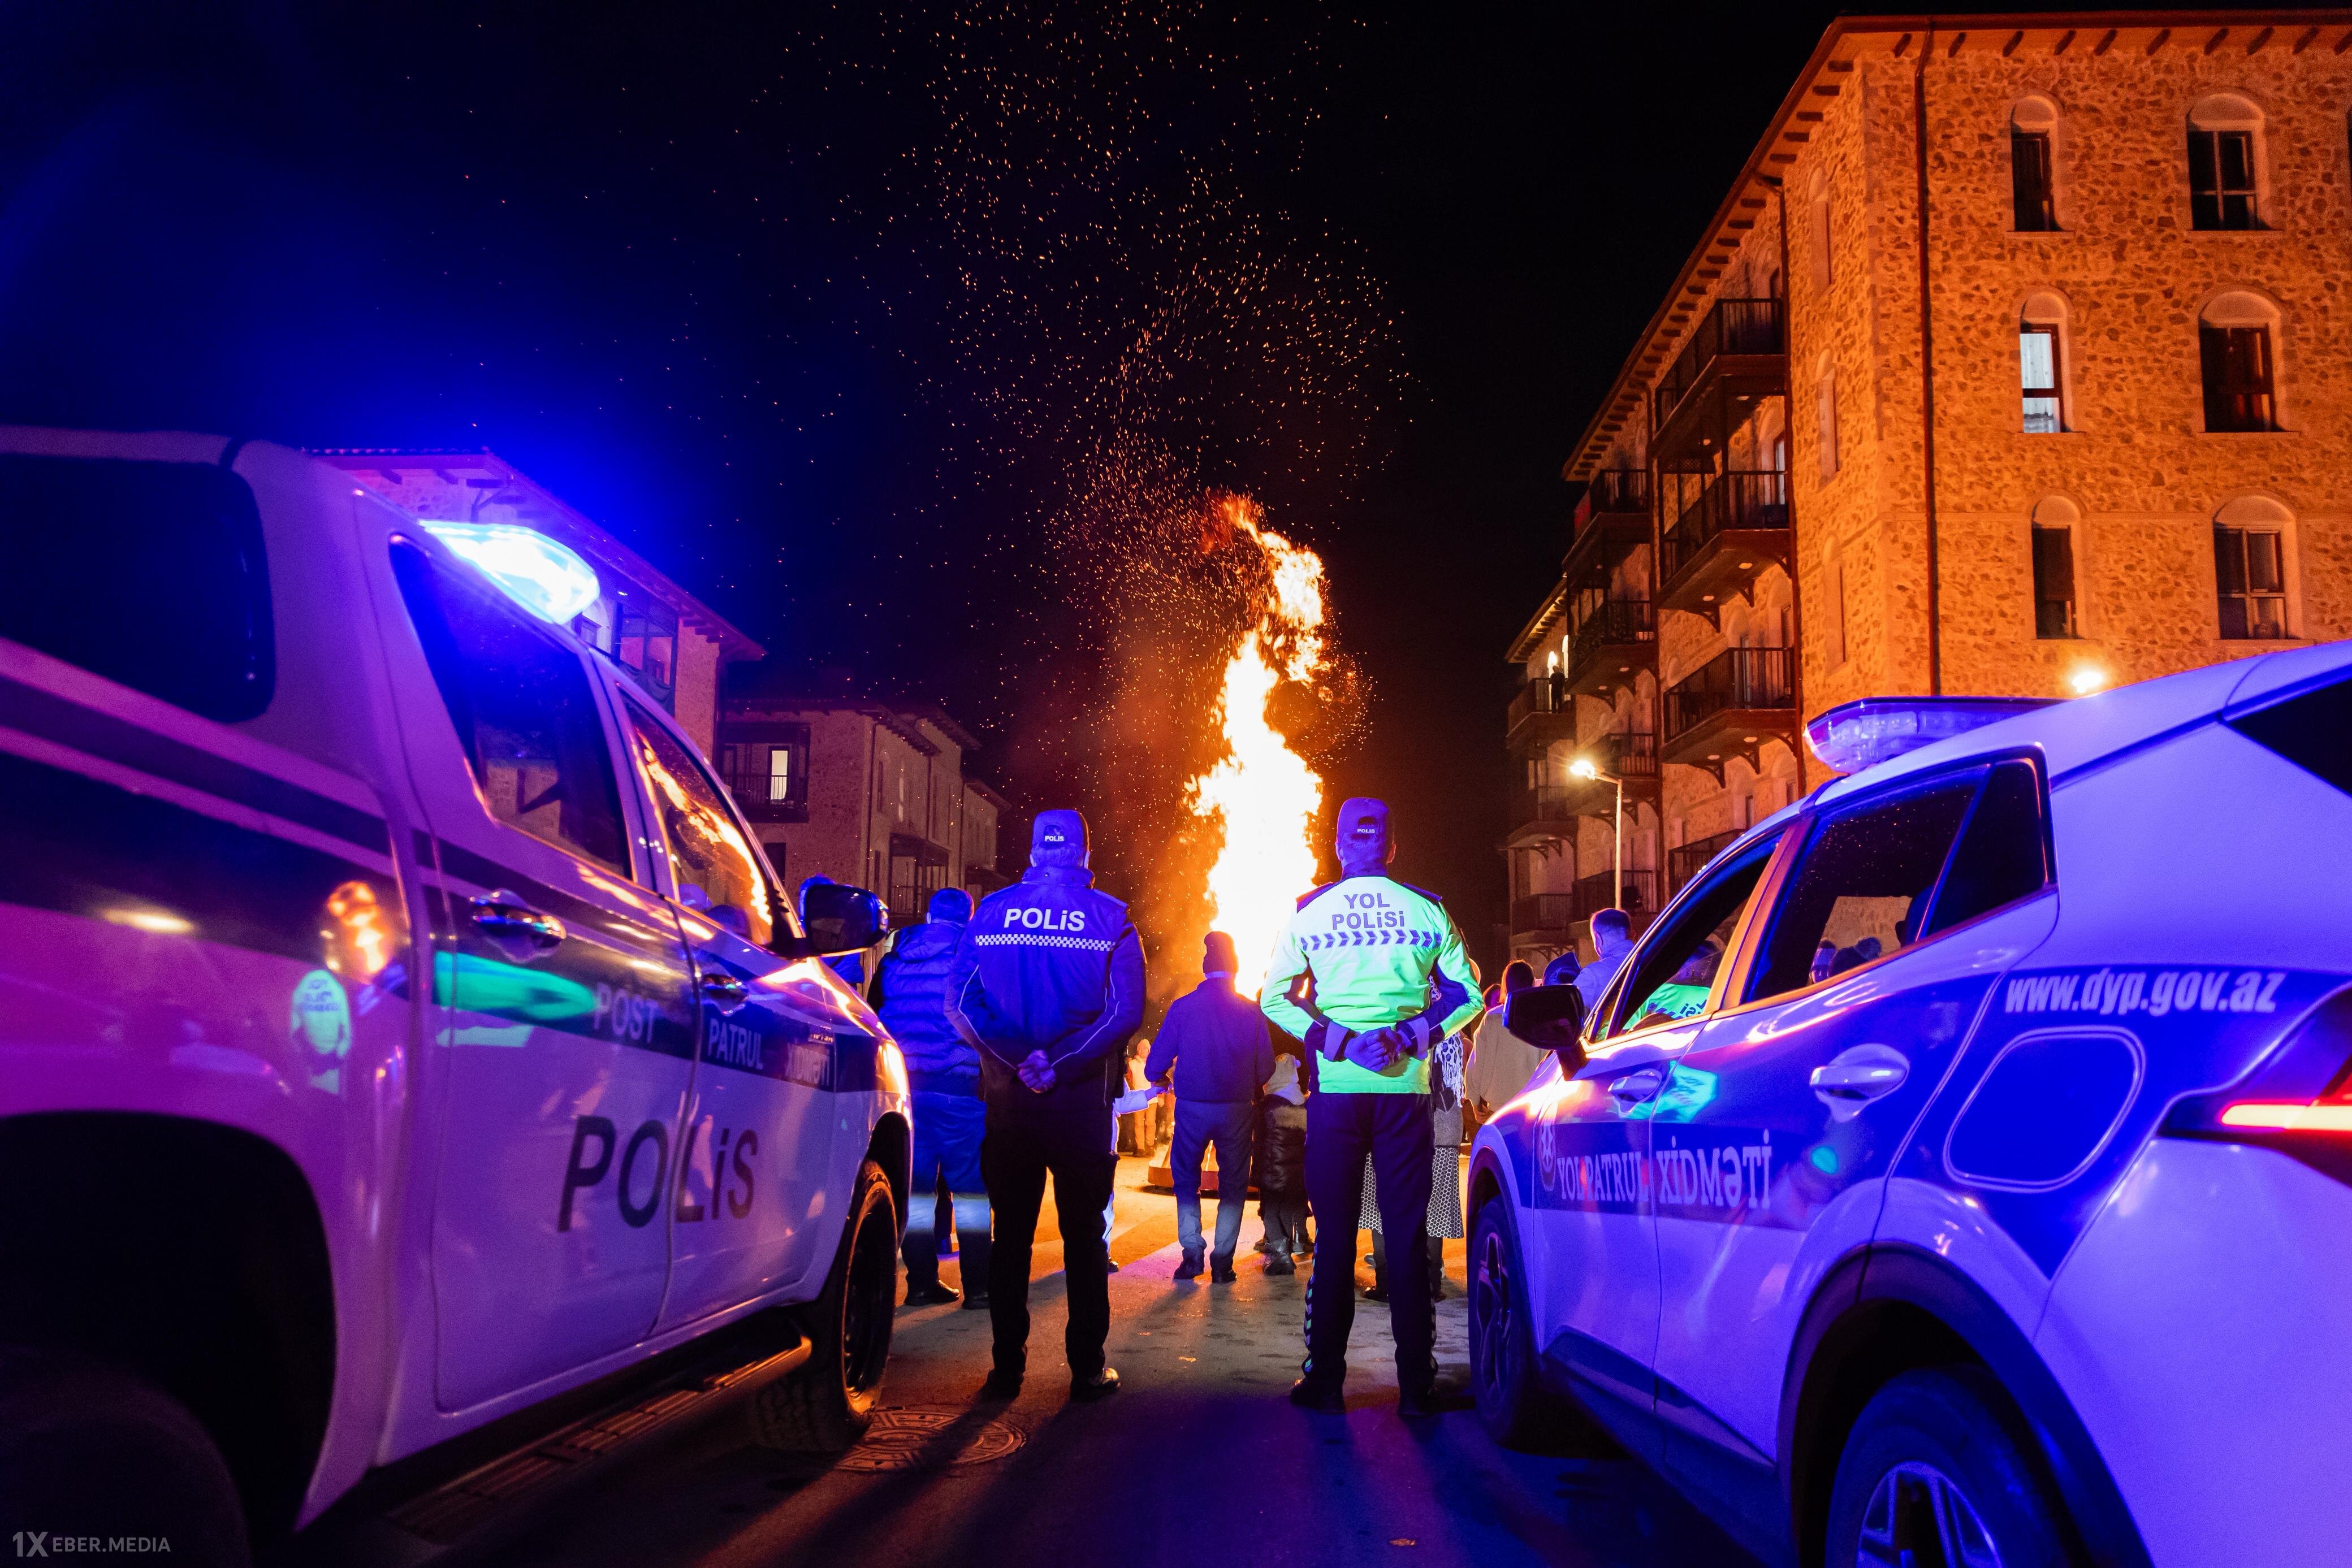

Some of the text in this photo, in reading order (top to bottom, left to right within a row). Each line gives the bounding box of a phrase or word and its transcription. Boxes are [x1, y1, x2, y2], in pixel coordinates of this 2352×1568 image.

[1344, 893, 1390, 909] YOL
[2005, 968, 2286, 1016] www.dyp.gov.az
[594, 983, 658, 1043] POST
[708, 1018, 763, 1069] PATRUL
[1557, 1128, 1772, 1209] YOL PATRUL XİDMƏTİ
